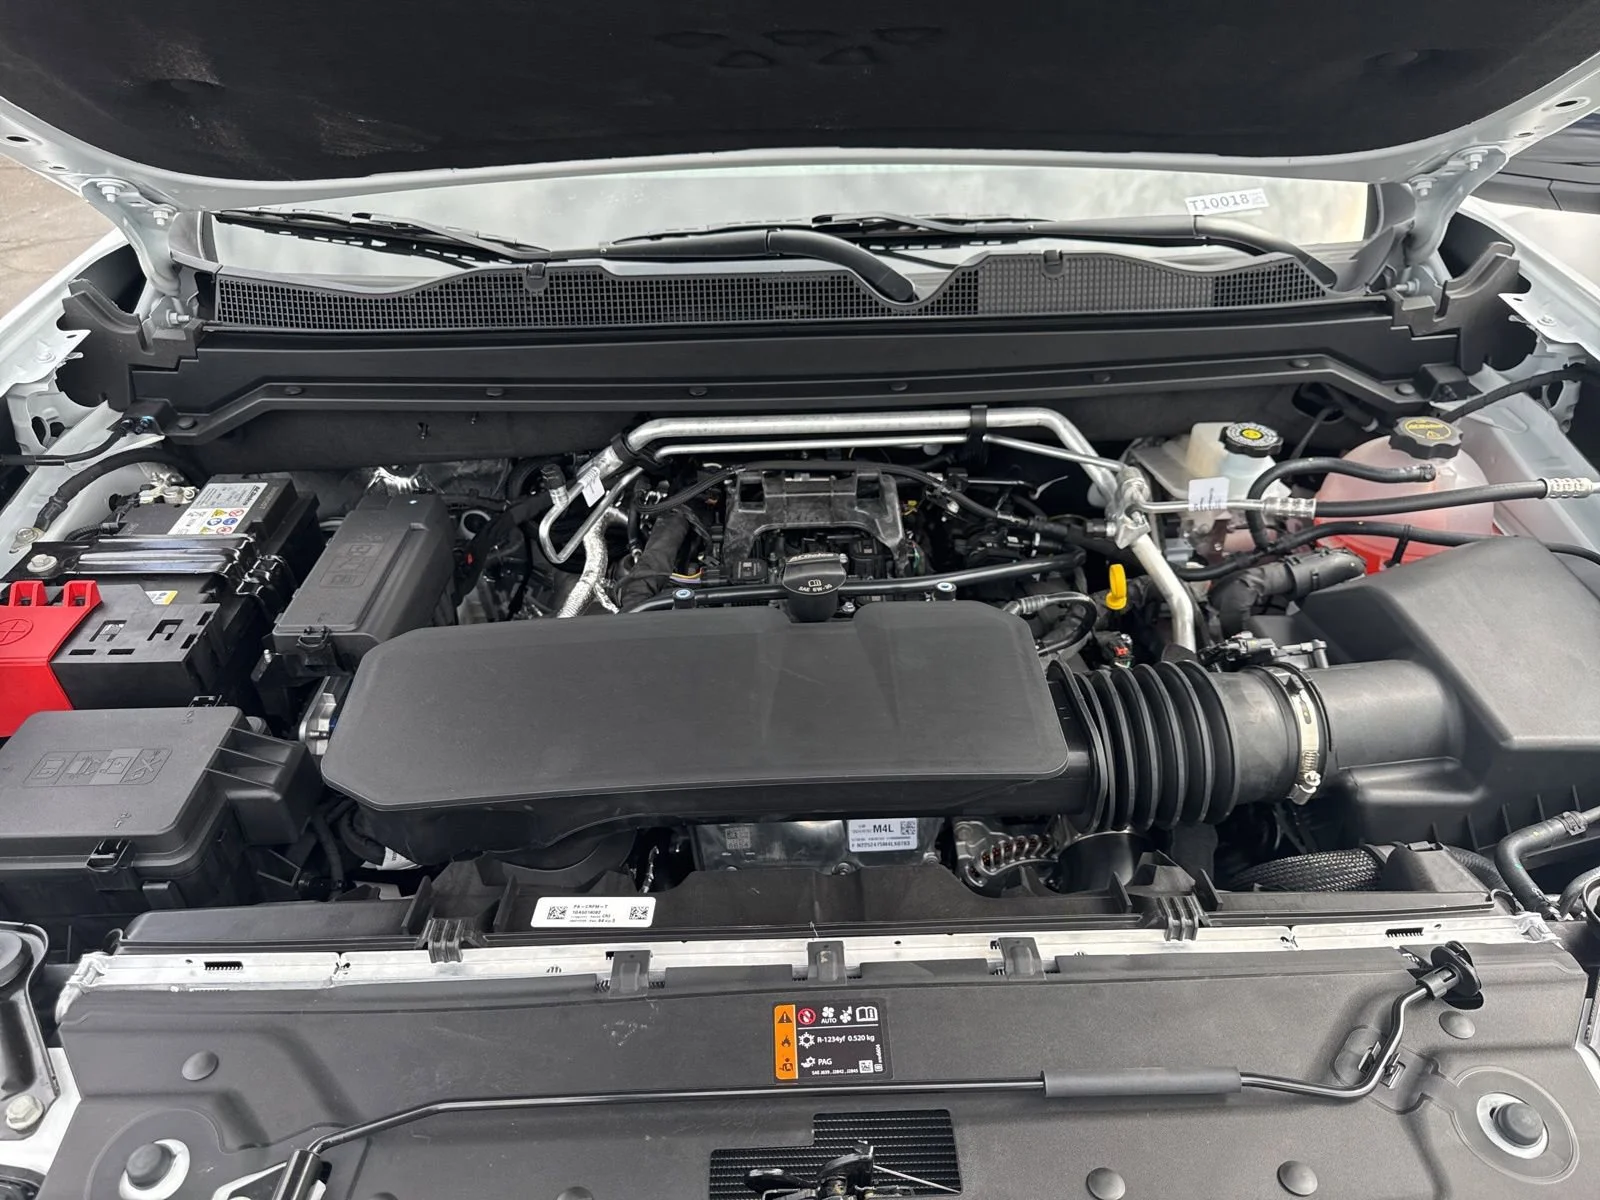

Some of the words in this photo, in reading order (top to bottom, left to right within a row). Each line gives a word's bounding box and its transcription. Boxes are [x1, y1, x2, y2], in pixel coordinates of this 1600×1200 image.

[1188, 193, 1250, 212] T10018
[873, 823, 894, 833] M4L
[817, 1035, 846, 1044] R-1234yf
[847, 1034, 866, 1042] 0.520
[866, 1034, 875, 1042] kg
[817, 1058, 833, 1066] PAG
